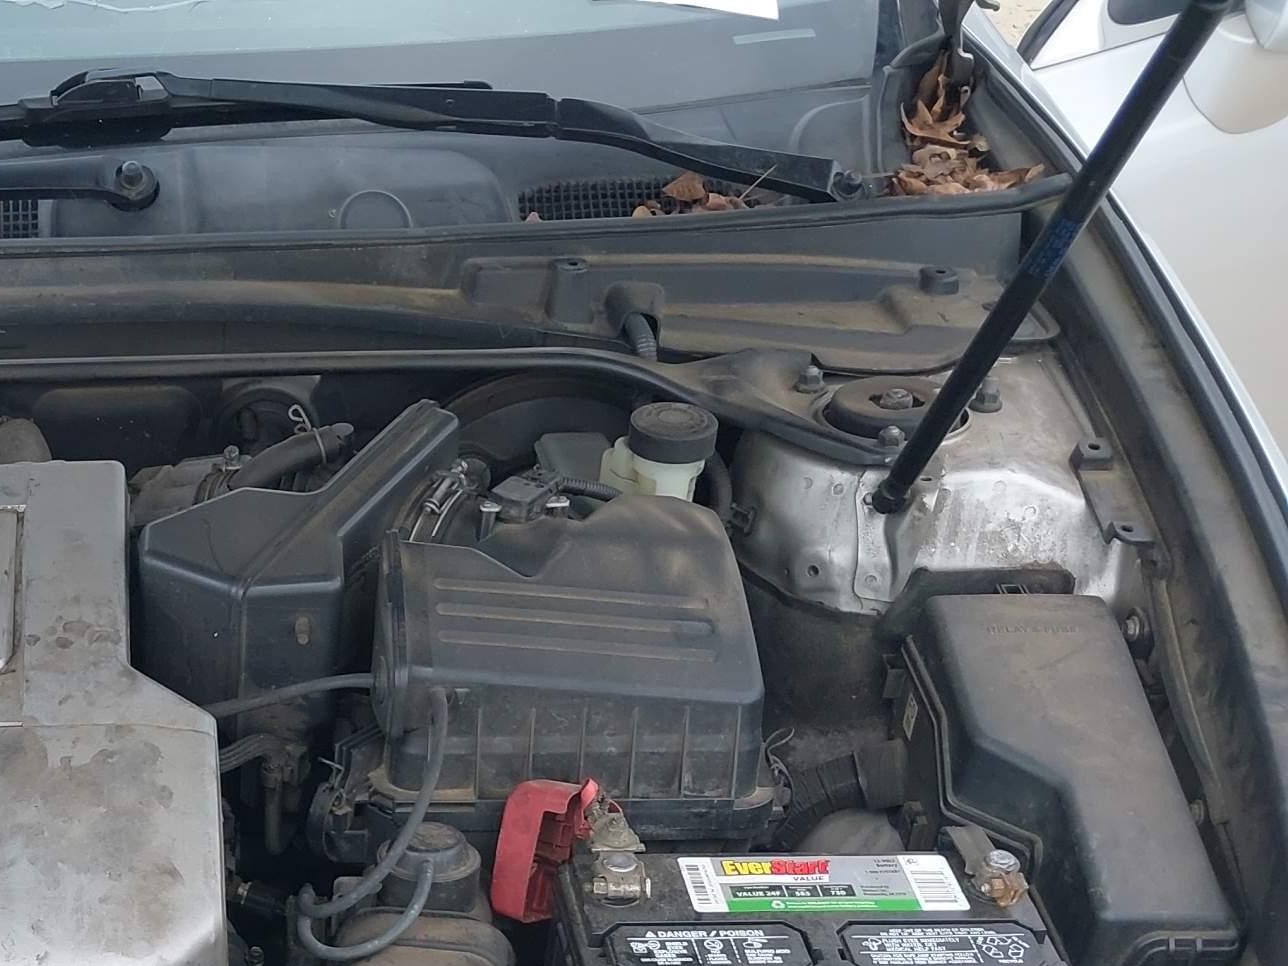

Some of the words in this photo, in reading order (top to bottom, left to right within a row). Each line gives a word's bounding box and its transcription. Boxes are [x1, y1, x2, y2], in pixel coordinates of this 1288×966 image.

[721, 859, 829, 876] EverStart
[657, 930, 708, 938] DANGER
[718, 929, 765, 937] POISON
